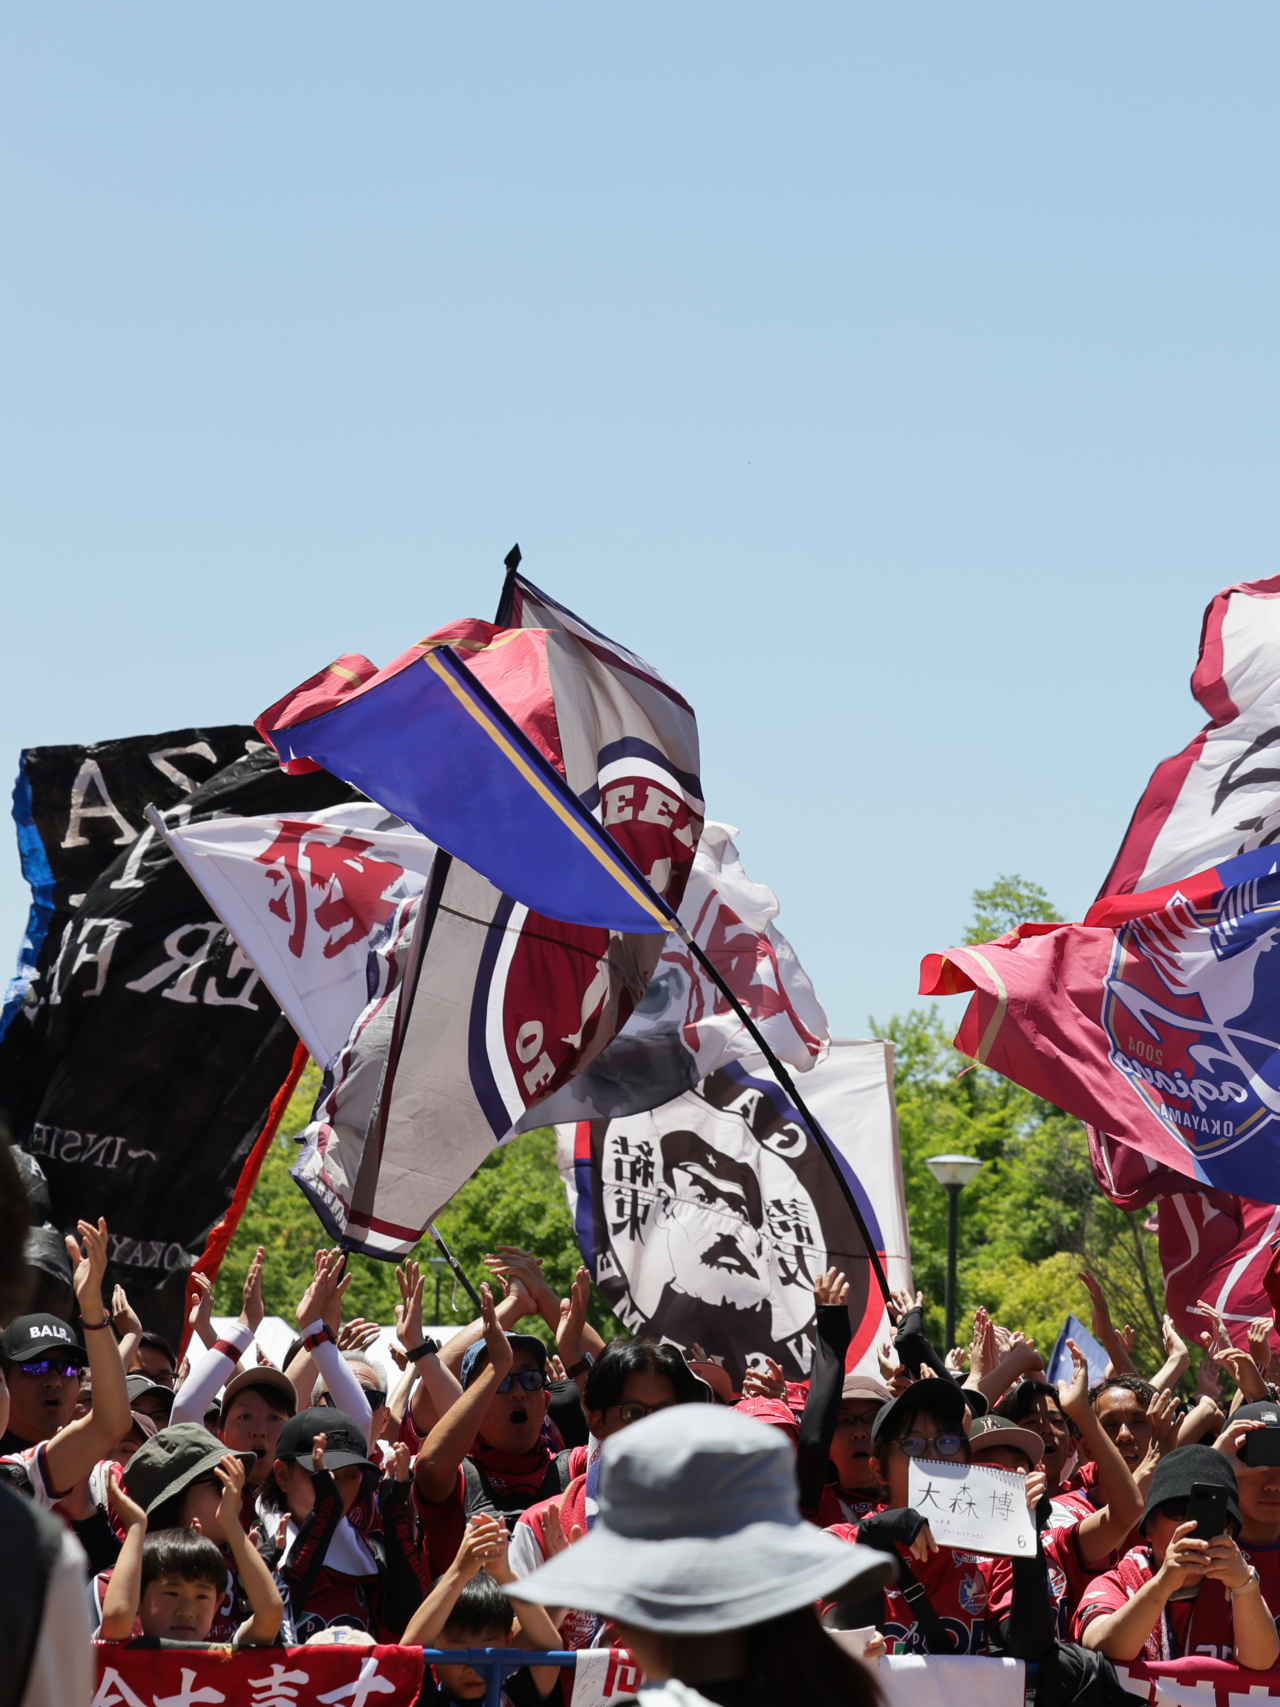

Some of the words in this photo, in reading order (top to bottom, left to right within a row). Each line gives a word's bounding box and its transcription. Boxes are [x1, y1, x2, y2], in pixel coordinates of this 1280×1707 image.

[914, 1481, 1015, 1521] 大森博
[1017, 1534, 1027, 1549] 6
